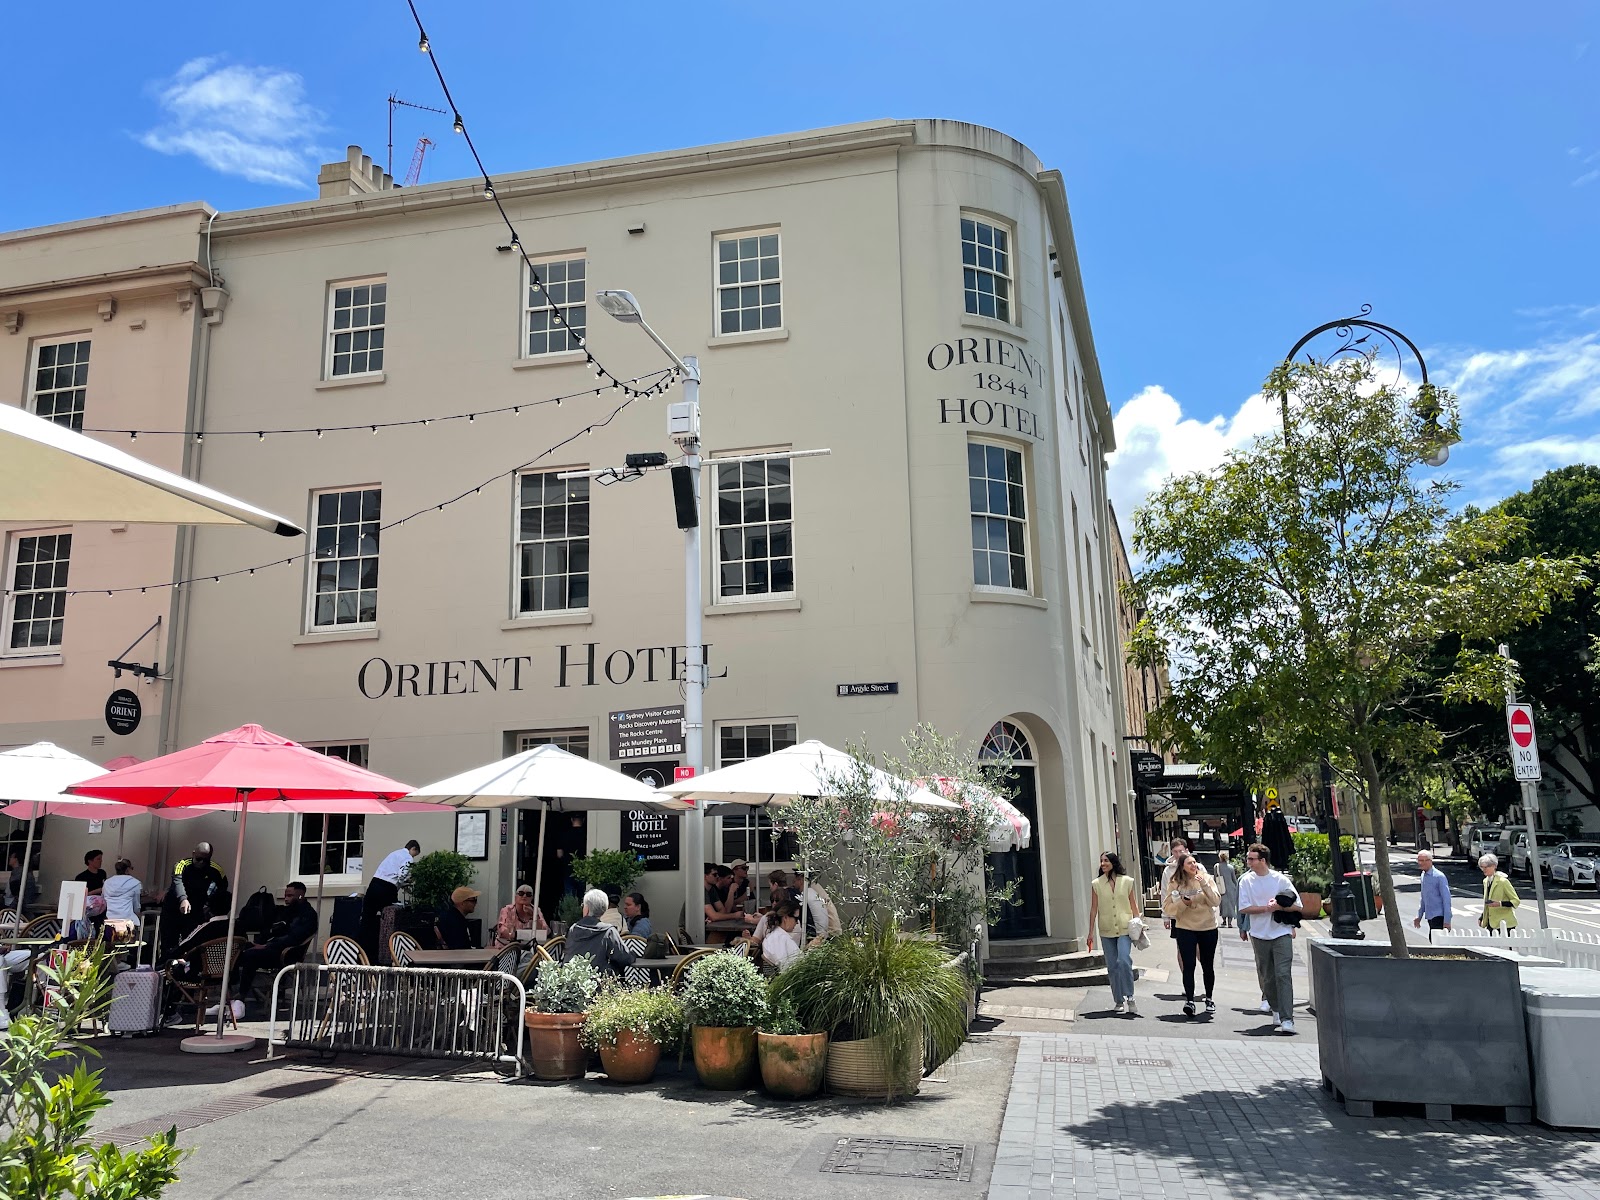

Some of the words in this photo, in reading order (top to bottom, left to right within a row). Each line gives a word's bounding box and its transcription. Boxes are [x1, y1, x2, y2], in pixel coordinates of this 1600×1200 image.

[927, 337, 1046, 390] ORIENT
[973, 372, 1030, 400] 1844
[936, 398, 1045, 441] HOTEL
[357, 656, 532, 700] ORIENT
[554, 642, 728, 688] HOTEL
[850, 684, 870, 694] Argyle
[870, 684, 890, 692] Street
[110, 706, 138, 718] ORIENT
[1519, 751, 1532, 762] NO
[1517, 765, 1538, 776] ENTRY
[1185, 782, 1206, 790] Studio
[632, 820, 668, 832] HOTEL
[652, 840, 668, 848] DINING
